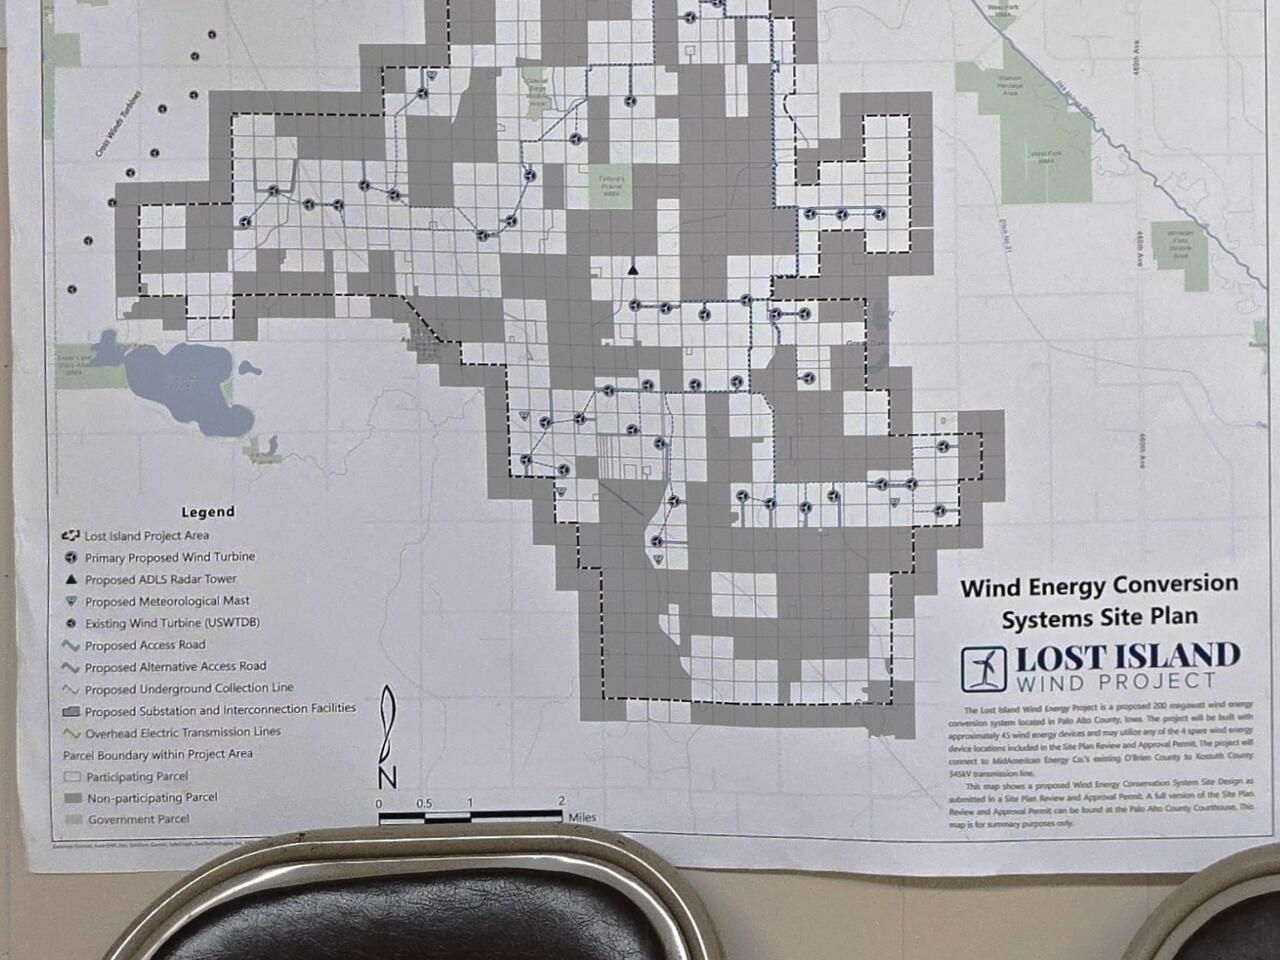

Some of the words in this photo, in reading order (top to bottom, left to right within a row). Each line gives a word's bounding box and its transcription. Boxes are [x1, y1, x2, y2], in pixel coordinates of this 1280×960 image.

[182, 505, 235, 520] Legend
[84, 531, 107, 541] Lost
[109, 531, 141, 541] Island
[144, 530, 182, 543] Project
[184, 531, 210, 540] Area
[85, 553, 126, 566] Primary
[128, 552, 179, 565] Proposed
[182, 552, 211, 562] Wind
[213, 551, 256, 561] Turbine
[85, 574, 136, 587] Proposed
[138, 575, 168, 584] ADLS
[170, 574, 203, 584] Radar
[204, 574, 237, 583] Tower
[960, 578, 1021, 597] Wind
[1029, 577, 1106, 600] Energy
[1113, 573, 1239, 593] Conversion
[85, 597, 136, 609] Proposed
[139, 596, 220, 609] Meteorological
[223, 595, 250, 605] Mast
[85, 618, 127, 631] Existing
[129, 618, 158, 628] Wind
[160, 618, 202, 628] Turbine
[204, 617, 260, 629] (USWTDB)
[1002, 609, 1094, 634] Systems
[1101, 607, 1143, 626] Site
[1151, 605, 1198, 625] Plan
[85, 640, 137, 654] Proposed
[139, 640, 176, 650] Access
[178, 639, 206, 650] Road
[1016, 645, 1107, 672] LOST
[1115, 642, 1241, 669] ISLAND
[85, 662, 137, 675] Proposed
[139, 661, 198, 672] Alternative
[199, 661, 237, 671] Access
[239, 660, 267, 671] Road
[1016, 675, 1084, 692] WIND
[1099, 672, 1216, 690] PROJECT
[85, 684, 137, 697] Proposed
[140, 683, 212, 697] Underground
[214, 682, 269, 693] Collection
[272, 682, 294, 692] Line
[84, 706, 136, 719] Proposed
[139, 706, 196, 716] Substation
[199, 705, 220, 715] and
[223, 704, 308, 717] Interconnection
[311, 702, 357, 713] Facilities
[85, 728, 137, 739] Overhead
[140, 727, 179, 738] Electric
[181, 727, 251, 739] Transmission
[254, 726, 282, 736] Lines
[62, 750, 95, 760] Parcel
[97, 750, 151, 763] Boundary
[151, 749, 185, 760] within
[188, 749, 226, 762] Project
[228, 749, 253, 758] Area
[86, 771, 154, 784] Participating
[156, 771, 189, 781] Parcel
[378, 765, 396, 790] N
[87, 793, 183, 806] Non-participating
[185, 792, 218, 802] Parcel
[375, 799, 383, 809] 0
[416, 798, 433, 808] 0.5
[467, 798, 472, 807] 1
[558, 796, 566, 806] 2
[88, 815, 155, 824] Government
[157, 814, 190, 824] Parcel
[568, 813, 597, 823] Miles
